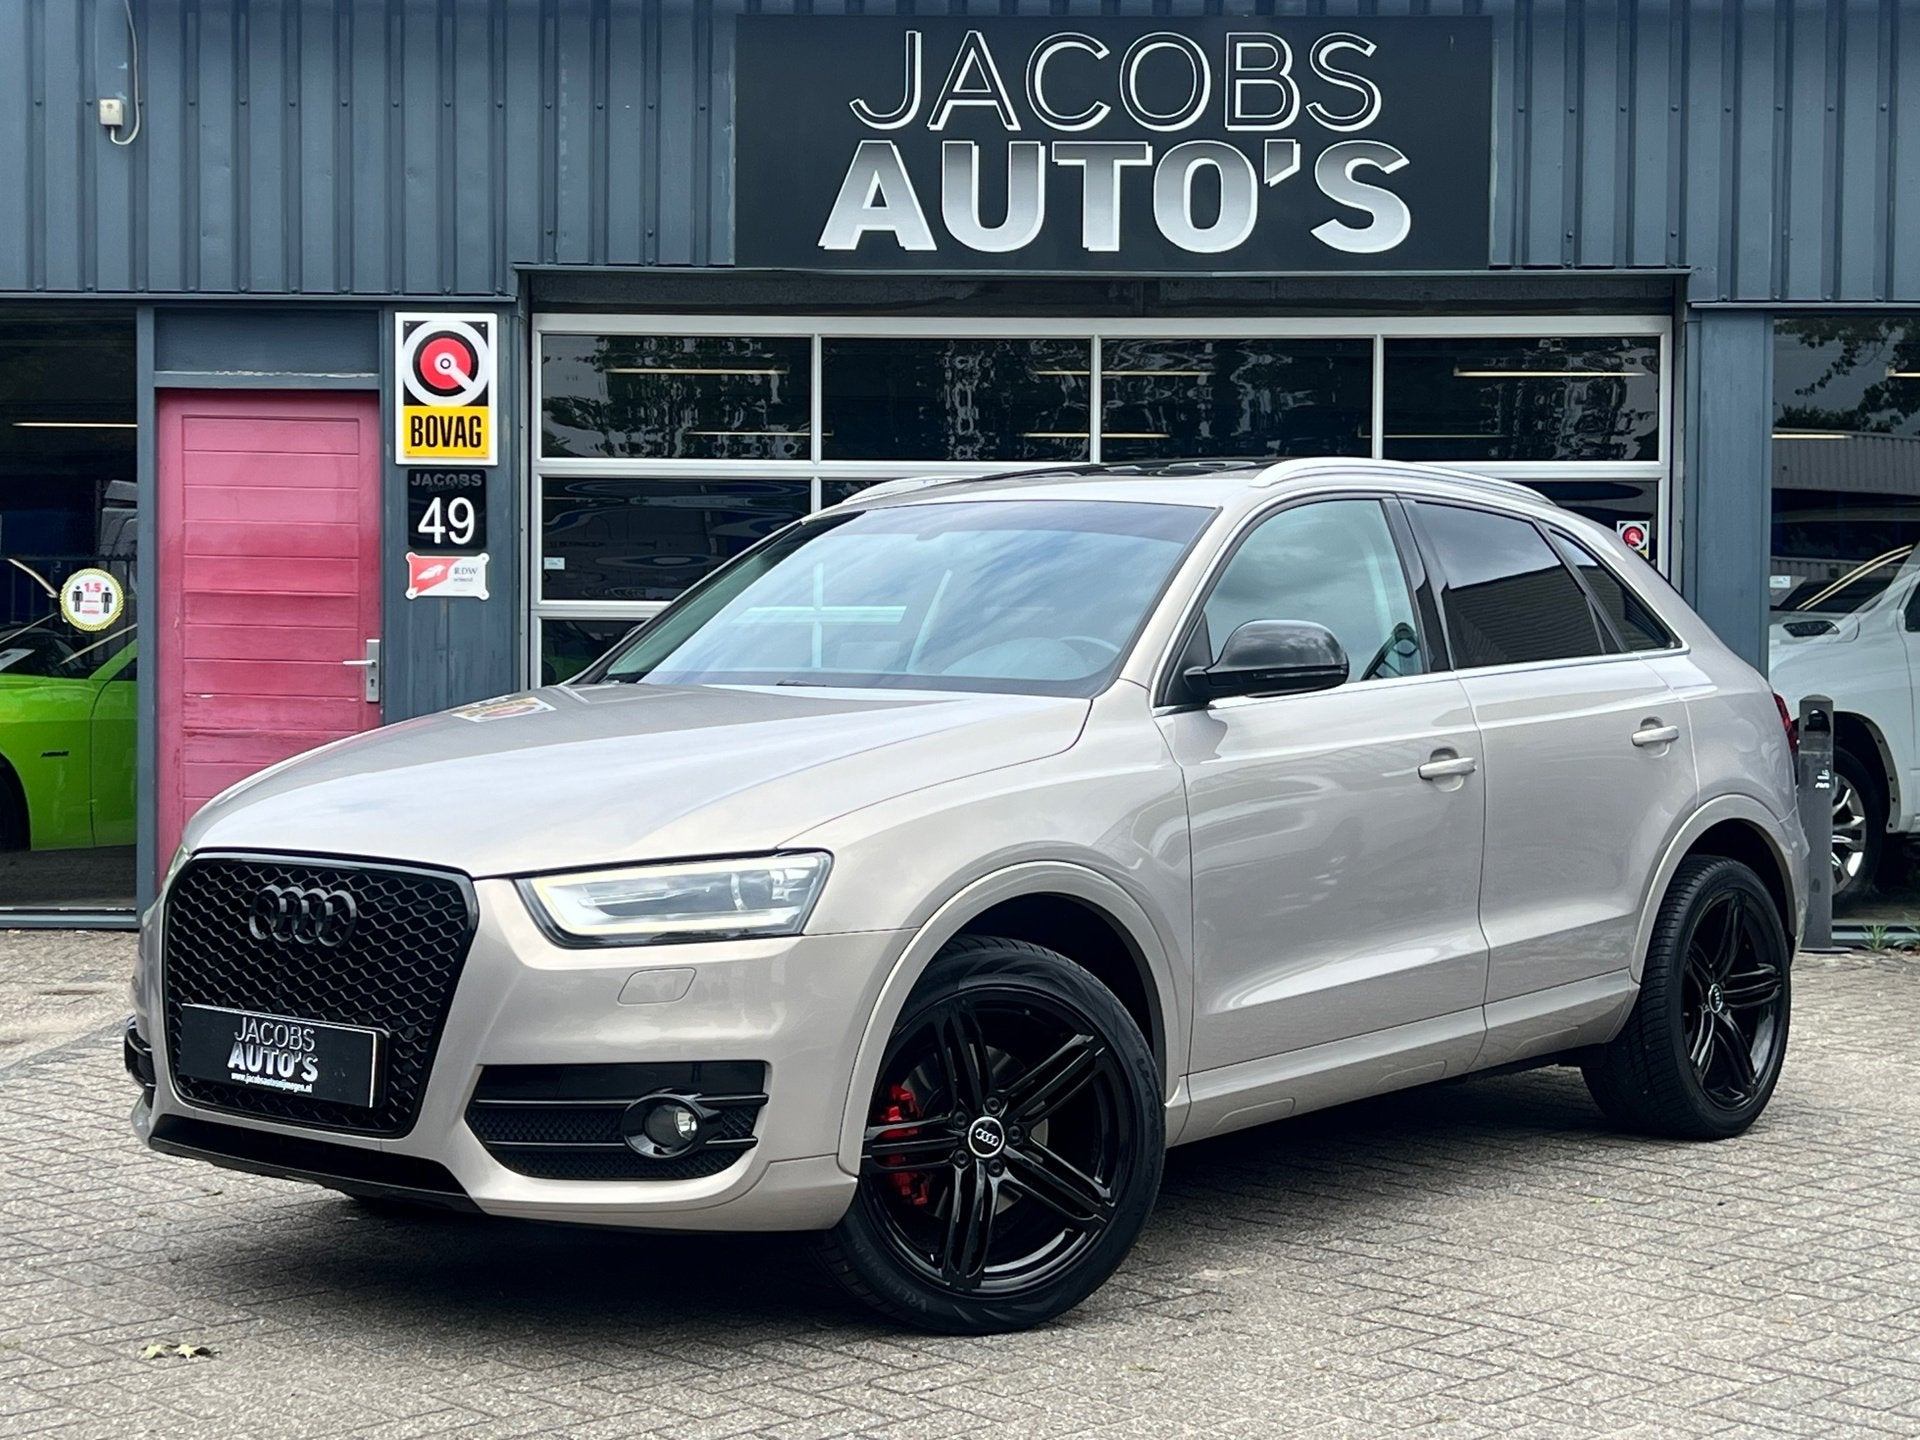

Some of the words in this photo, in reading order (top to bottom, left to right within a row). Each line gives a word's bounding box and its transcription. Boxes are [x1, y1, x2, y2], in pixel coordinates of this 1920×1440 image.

[849, 30, 1382, 132] JACOBS
[818, 138, 1412, 253] AUTO'S
[410, 415, 482, 448] BOVAG
[410, 473, 482, 487] JACOBS
[417, 497, 475, 545] 49
[454, 567, 478, 575] RDW
[234, 1016, 316, 1052] JACOBS
[227, 1042, 319, 1082] AUTO'S
